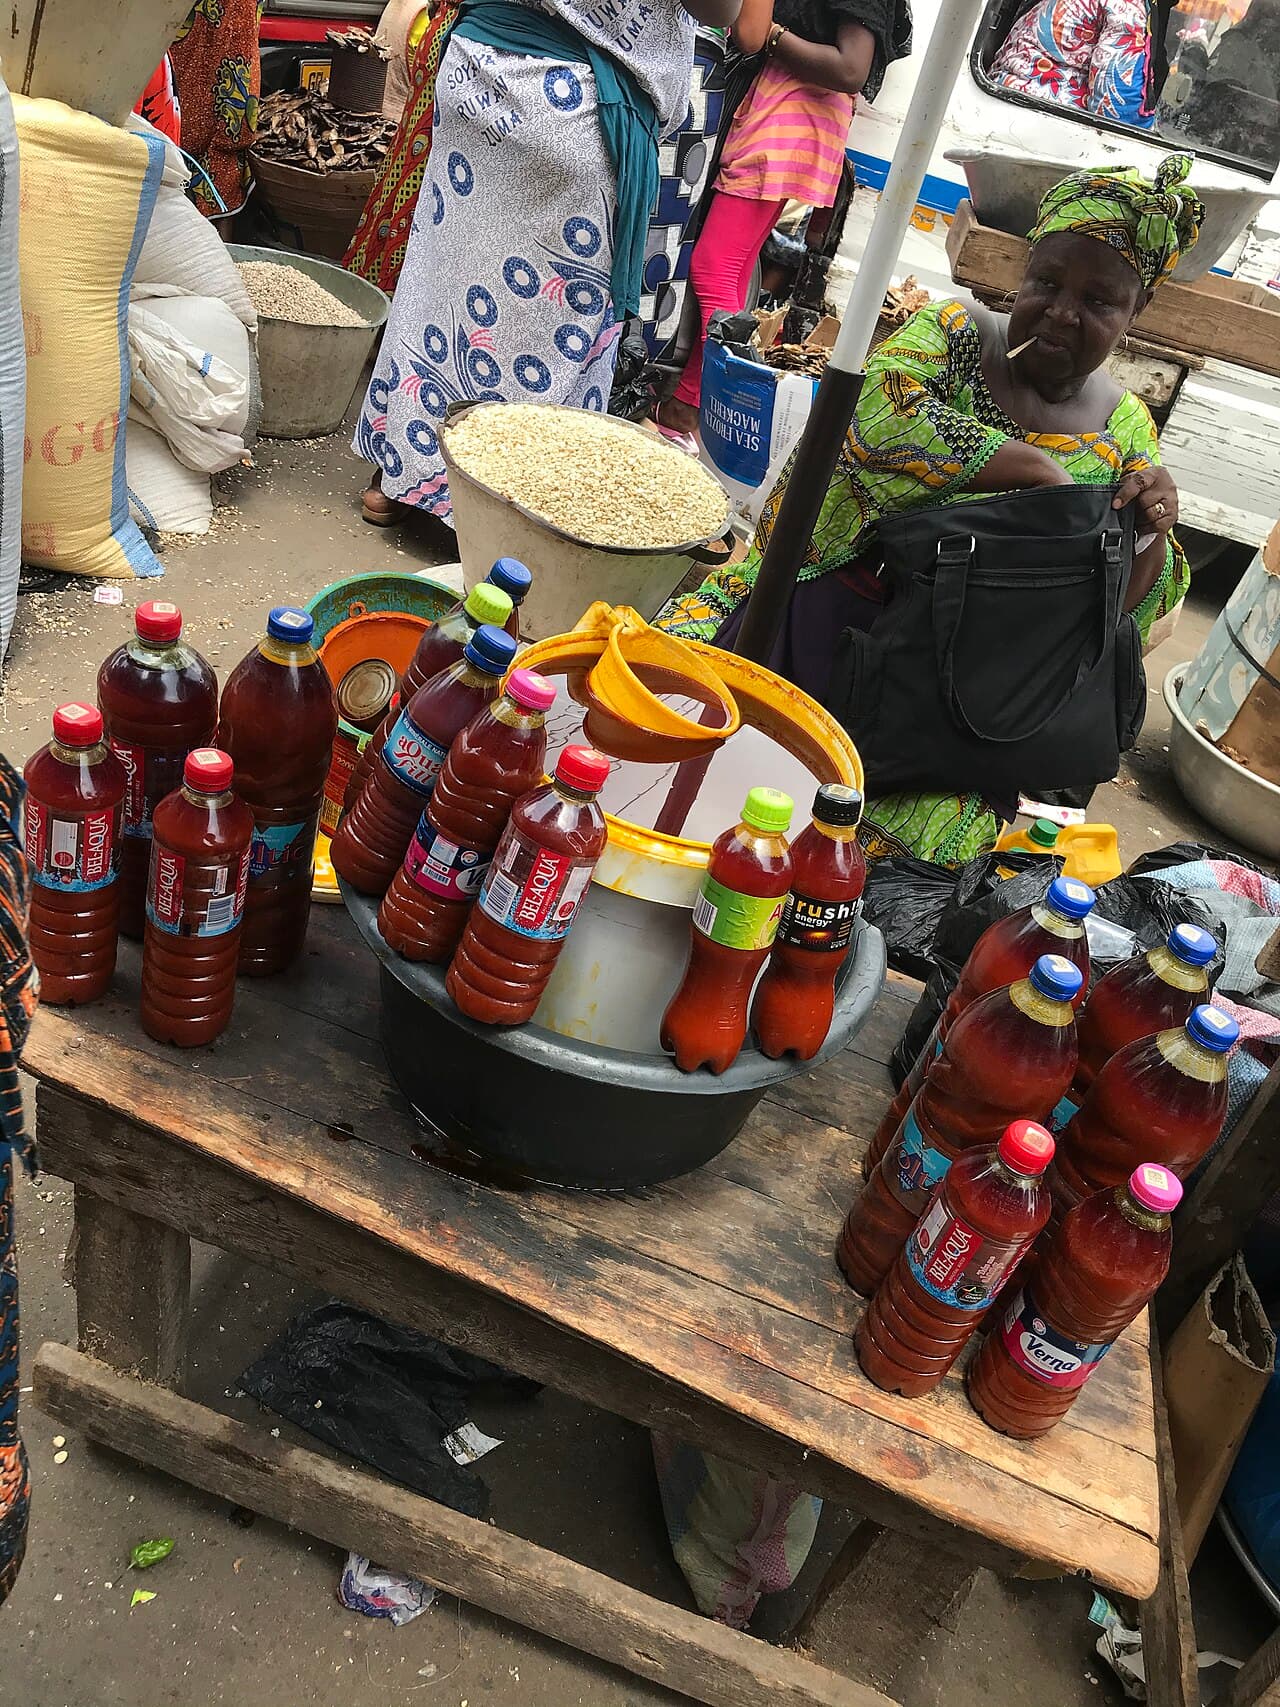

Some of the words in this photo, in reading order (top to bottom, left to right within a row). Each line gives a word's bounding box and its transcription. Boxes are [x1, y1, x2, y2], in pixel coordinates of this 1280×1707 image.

[456, 74, 509, 124] RUWAN
[480, 108, 523, 147] ZUMA
[734, 428, 761, 452] SEA
[794, 912, 828, 928] energy
[796, 900, 856, 920] rush!
[1026, 1334, 1077, 1372] Verna
